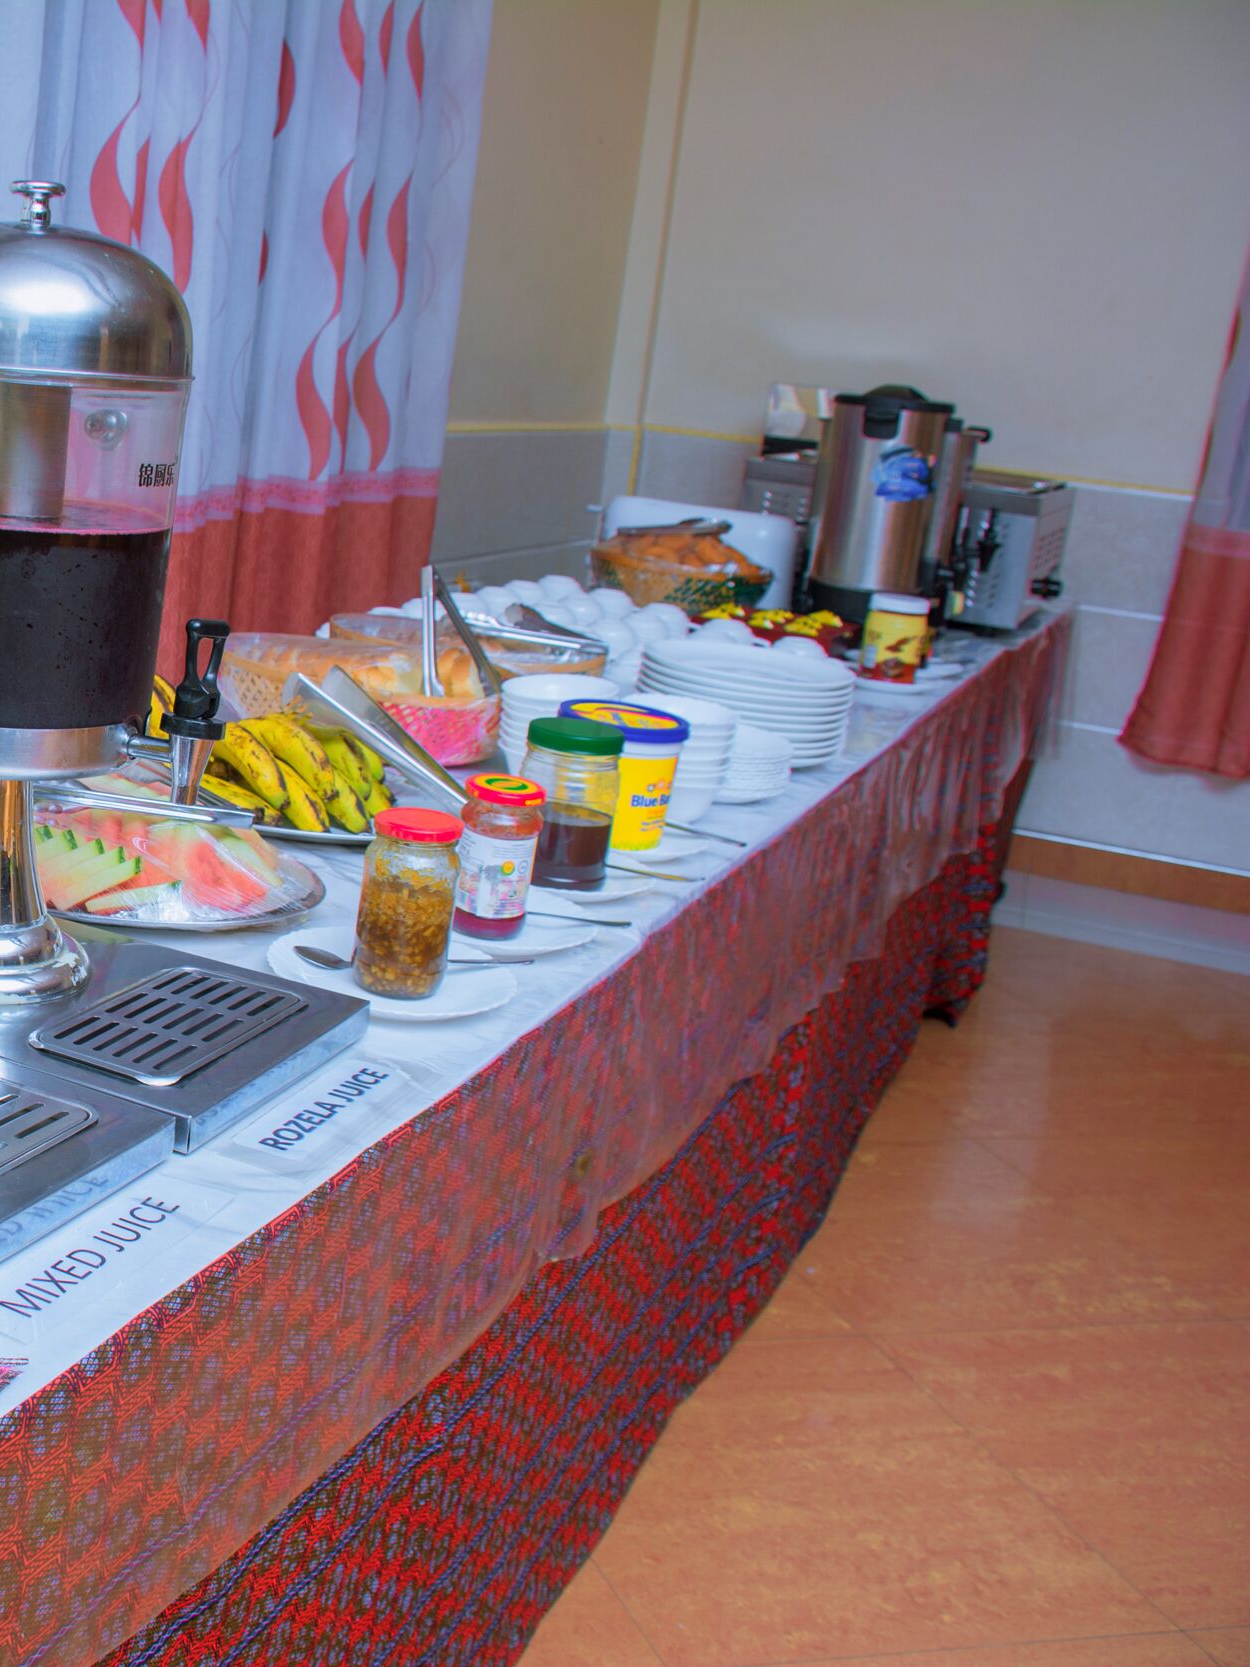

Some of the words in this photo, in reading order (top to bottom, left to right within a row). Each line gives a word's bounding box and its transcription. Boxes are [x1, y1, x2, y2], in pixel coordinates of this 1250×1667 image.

[630, 794, 658, 807] Blue
[258, 1101, 347, 1151] ROZELA
[327, 1068, 389, 1102] JUICE
[93, 1196, 181, 1252] JUICE
